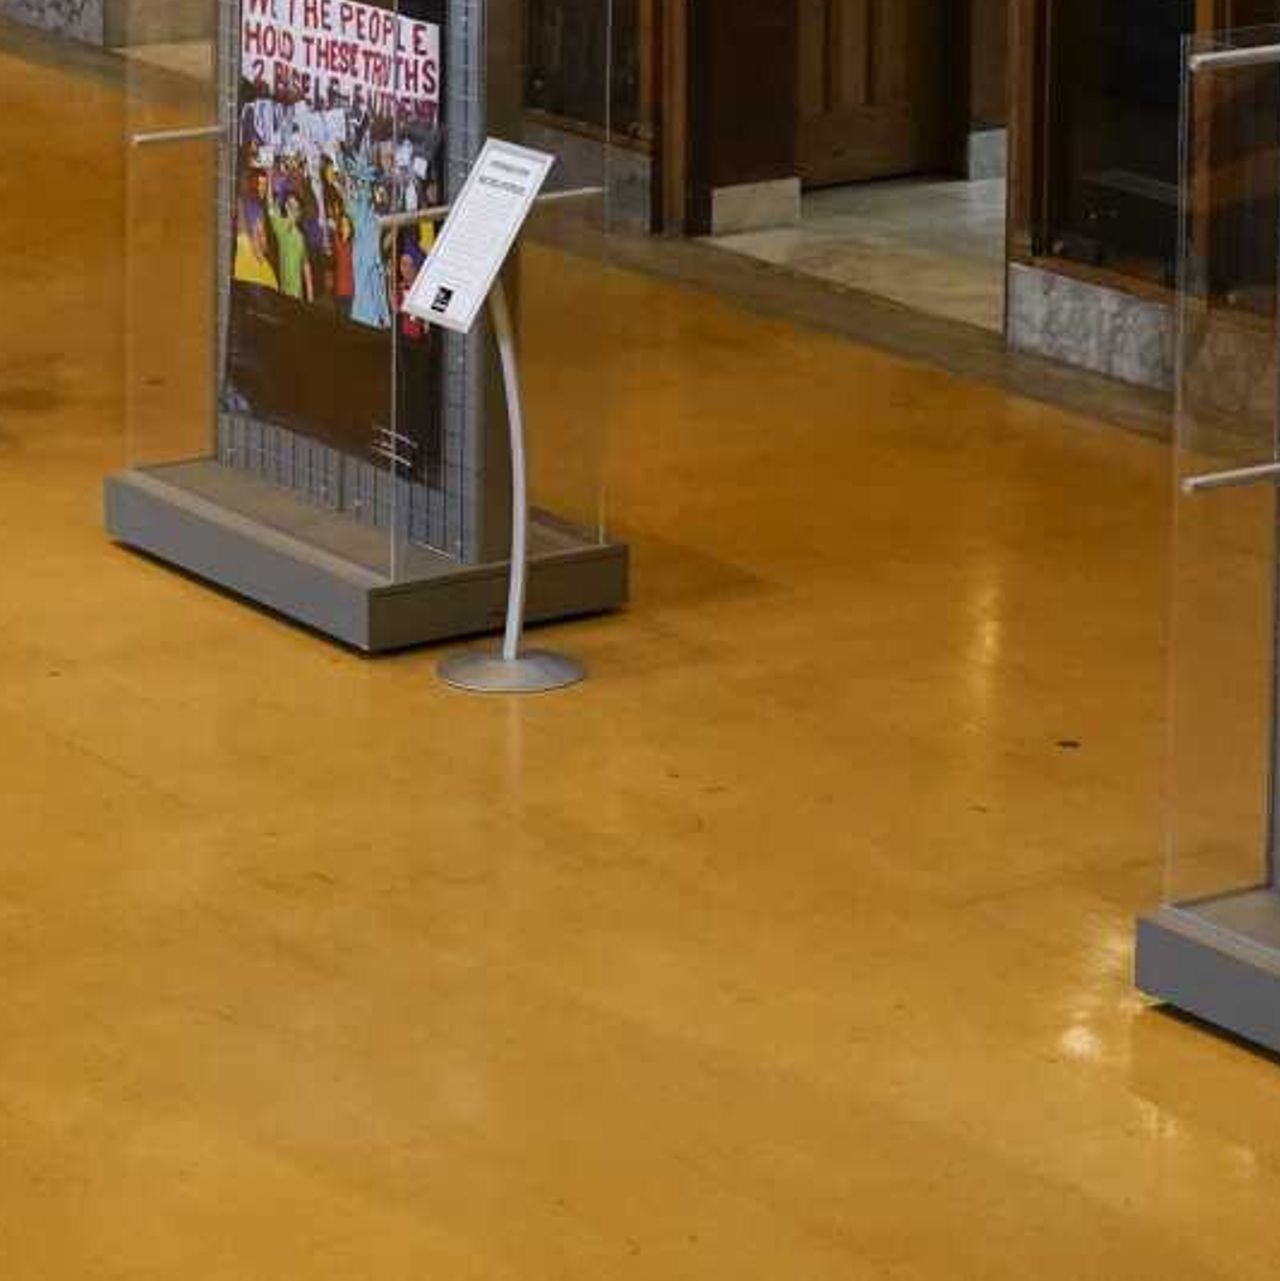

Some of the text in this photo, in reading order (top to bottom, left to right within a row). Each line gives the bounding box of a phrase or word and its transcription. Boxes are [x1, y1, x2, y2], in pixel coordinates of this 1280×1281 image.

[244, 22, 436, 95] HOLD THESE TRUTHS
[339, 2, 427, 56] PEOPLE
